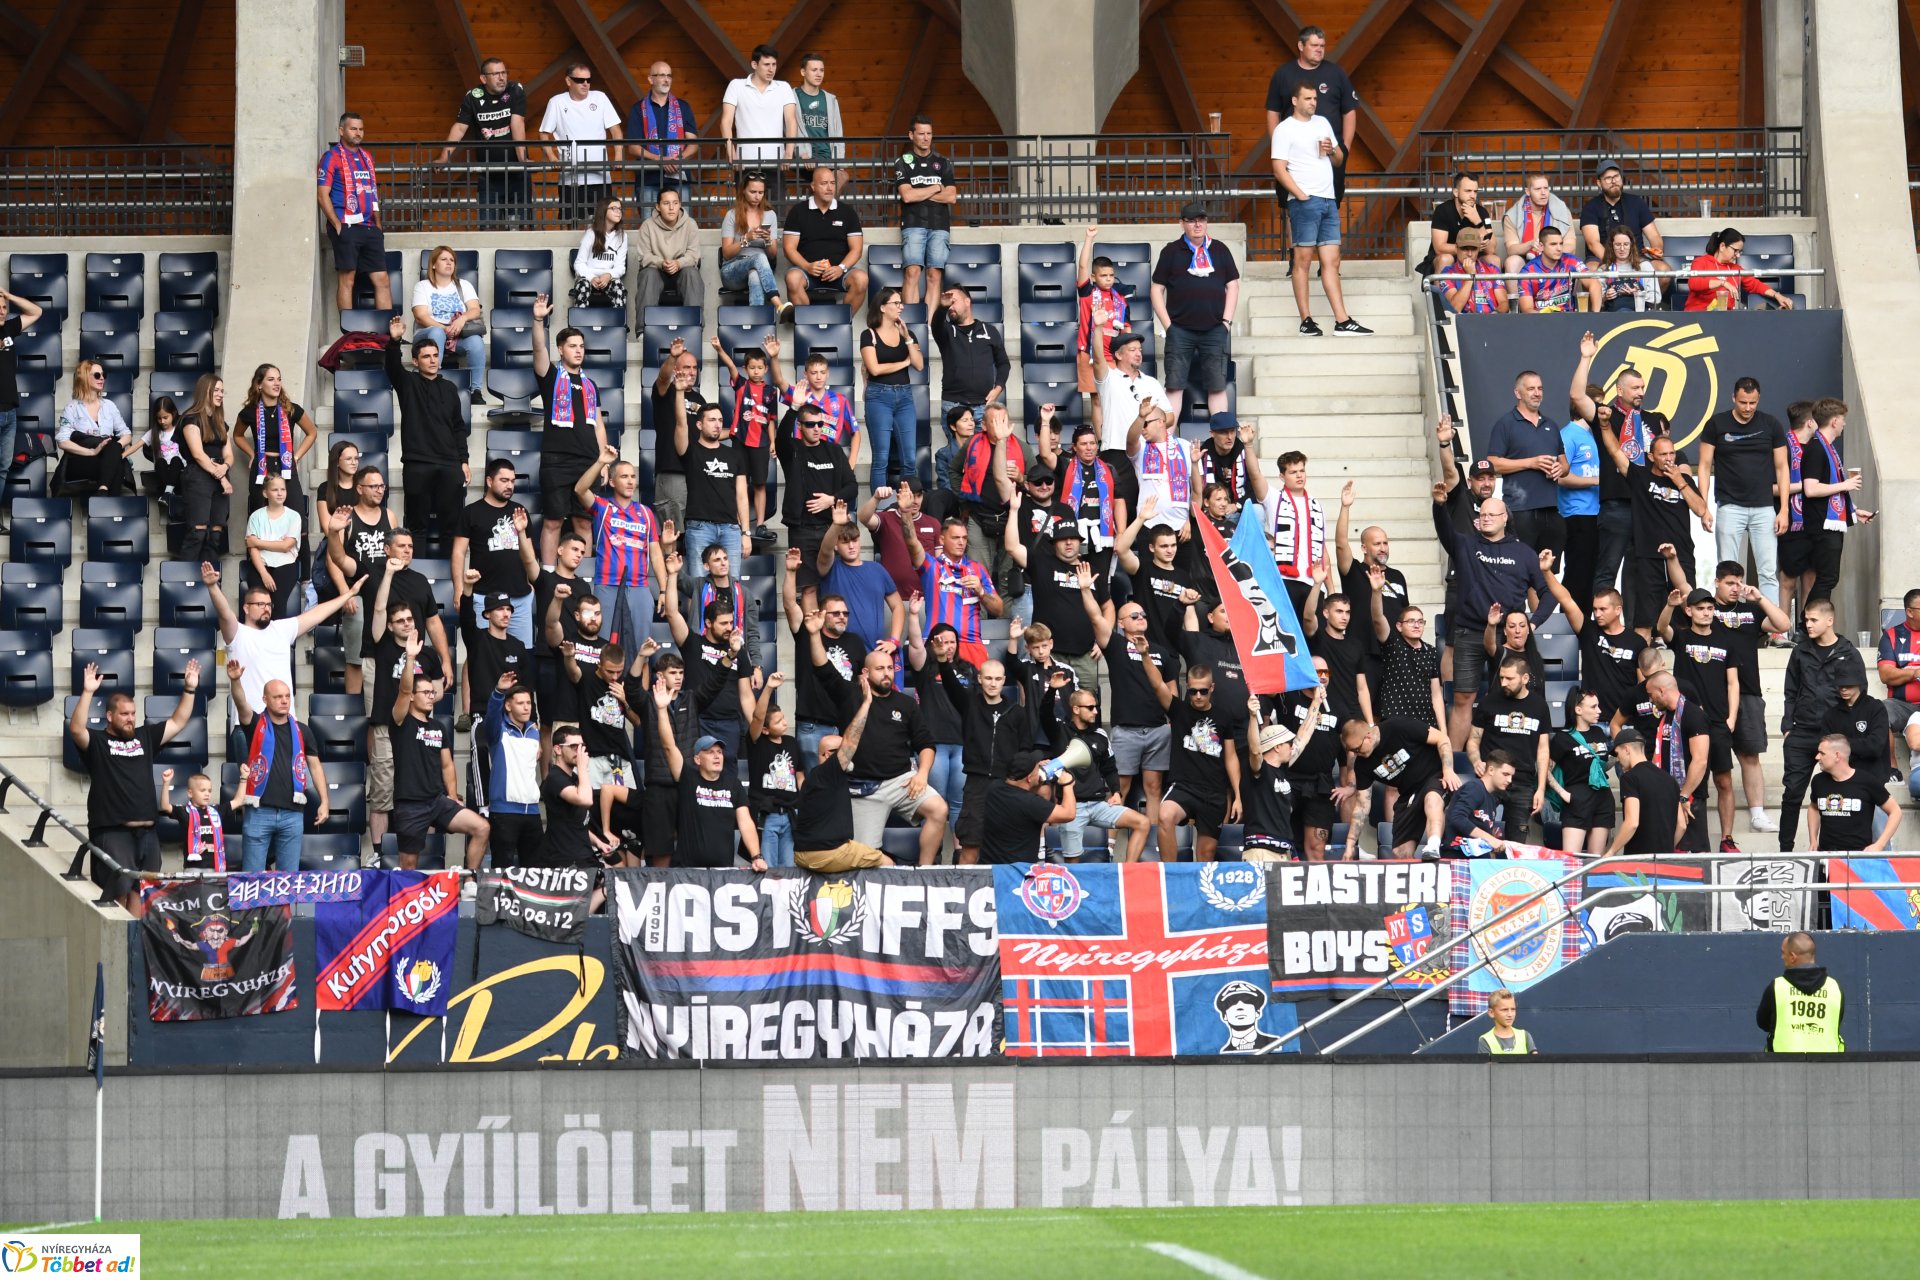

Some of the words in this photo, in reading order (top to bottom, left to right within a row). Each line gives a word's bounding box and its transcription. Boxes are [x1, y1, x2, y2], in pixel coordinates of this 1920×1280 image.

[1216, 871, 1254, 886] 1928
[157, 897, 200, 913] RUM
[327, 879, 450, 1001] Kutymorgók
[1013, 936, 1269, 973] Nyíregyháza
[1283, 930, 1389, 975] BOYS
[150, 962, 292, 1001] NYÍREGYHÁZA
[622, 995, 995, 1060] NYÍREGYHÁZA
[1789, 1000, 1827, 1019] 1988
[278, 1134, 331, 1220] A
[353, 1113, 738, 1219] GYŰLÖLET
[763, 1083, 1015, 1212] NEM
[1041, 1110, 1303, 1208] PÁLYA!
